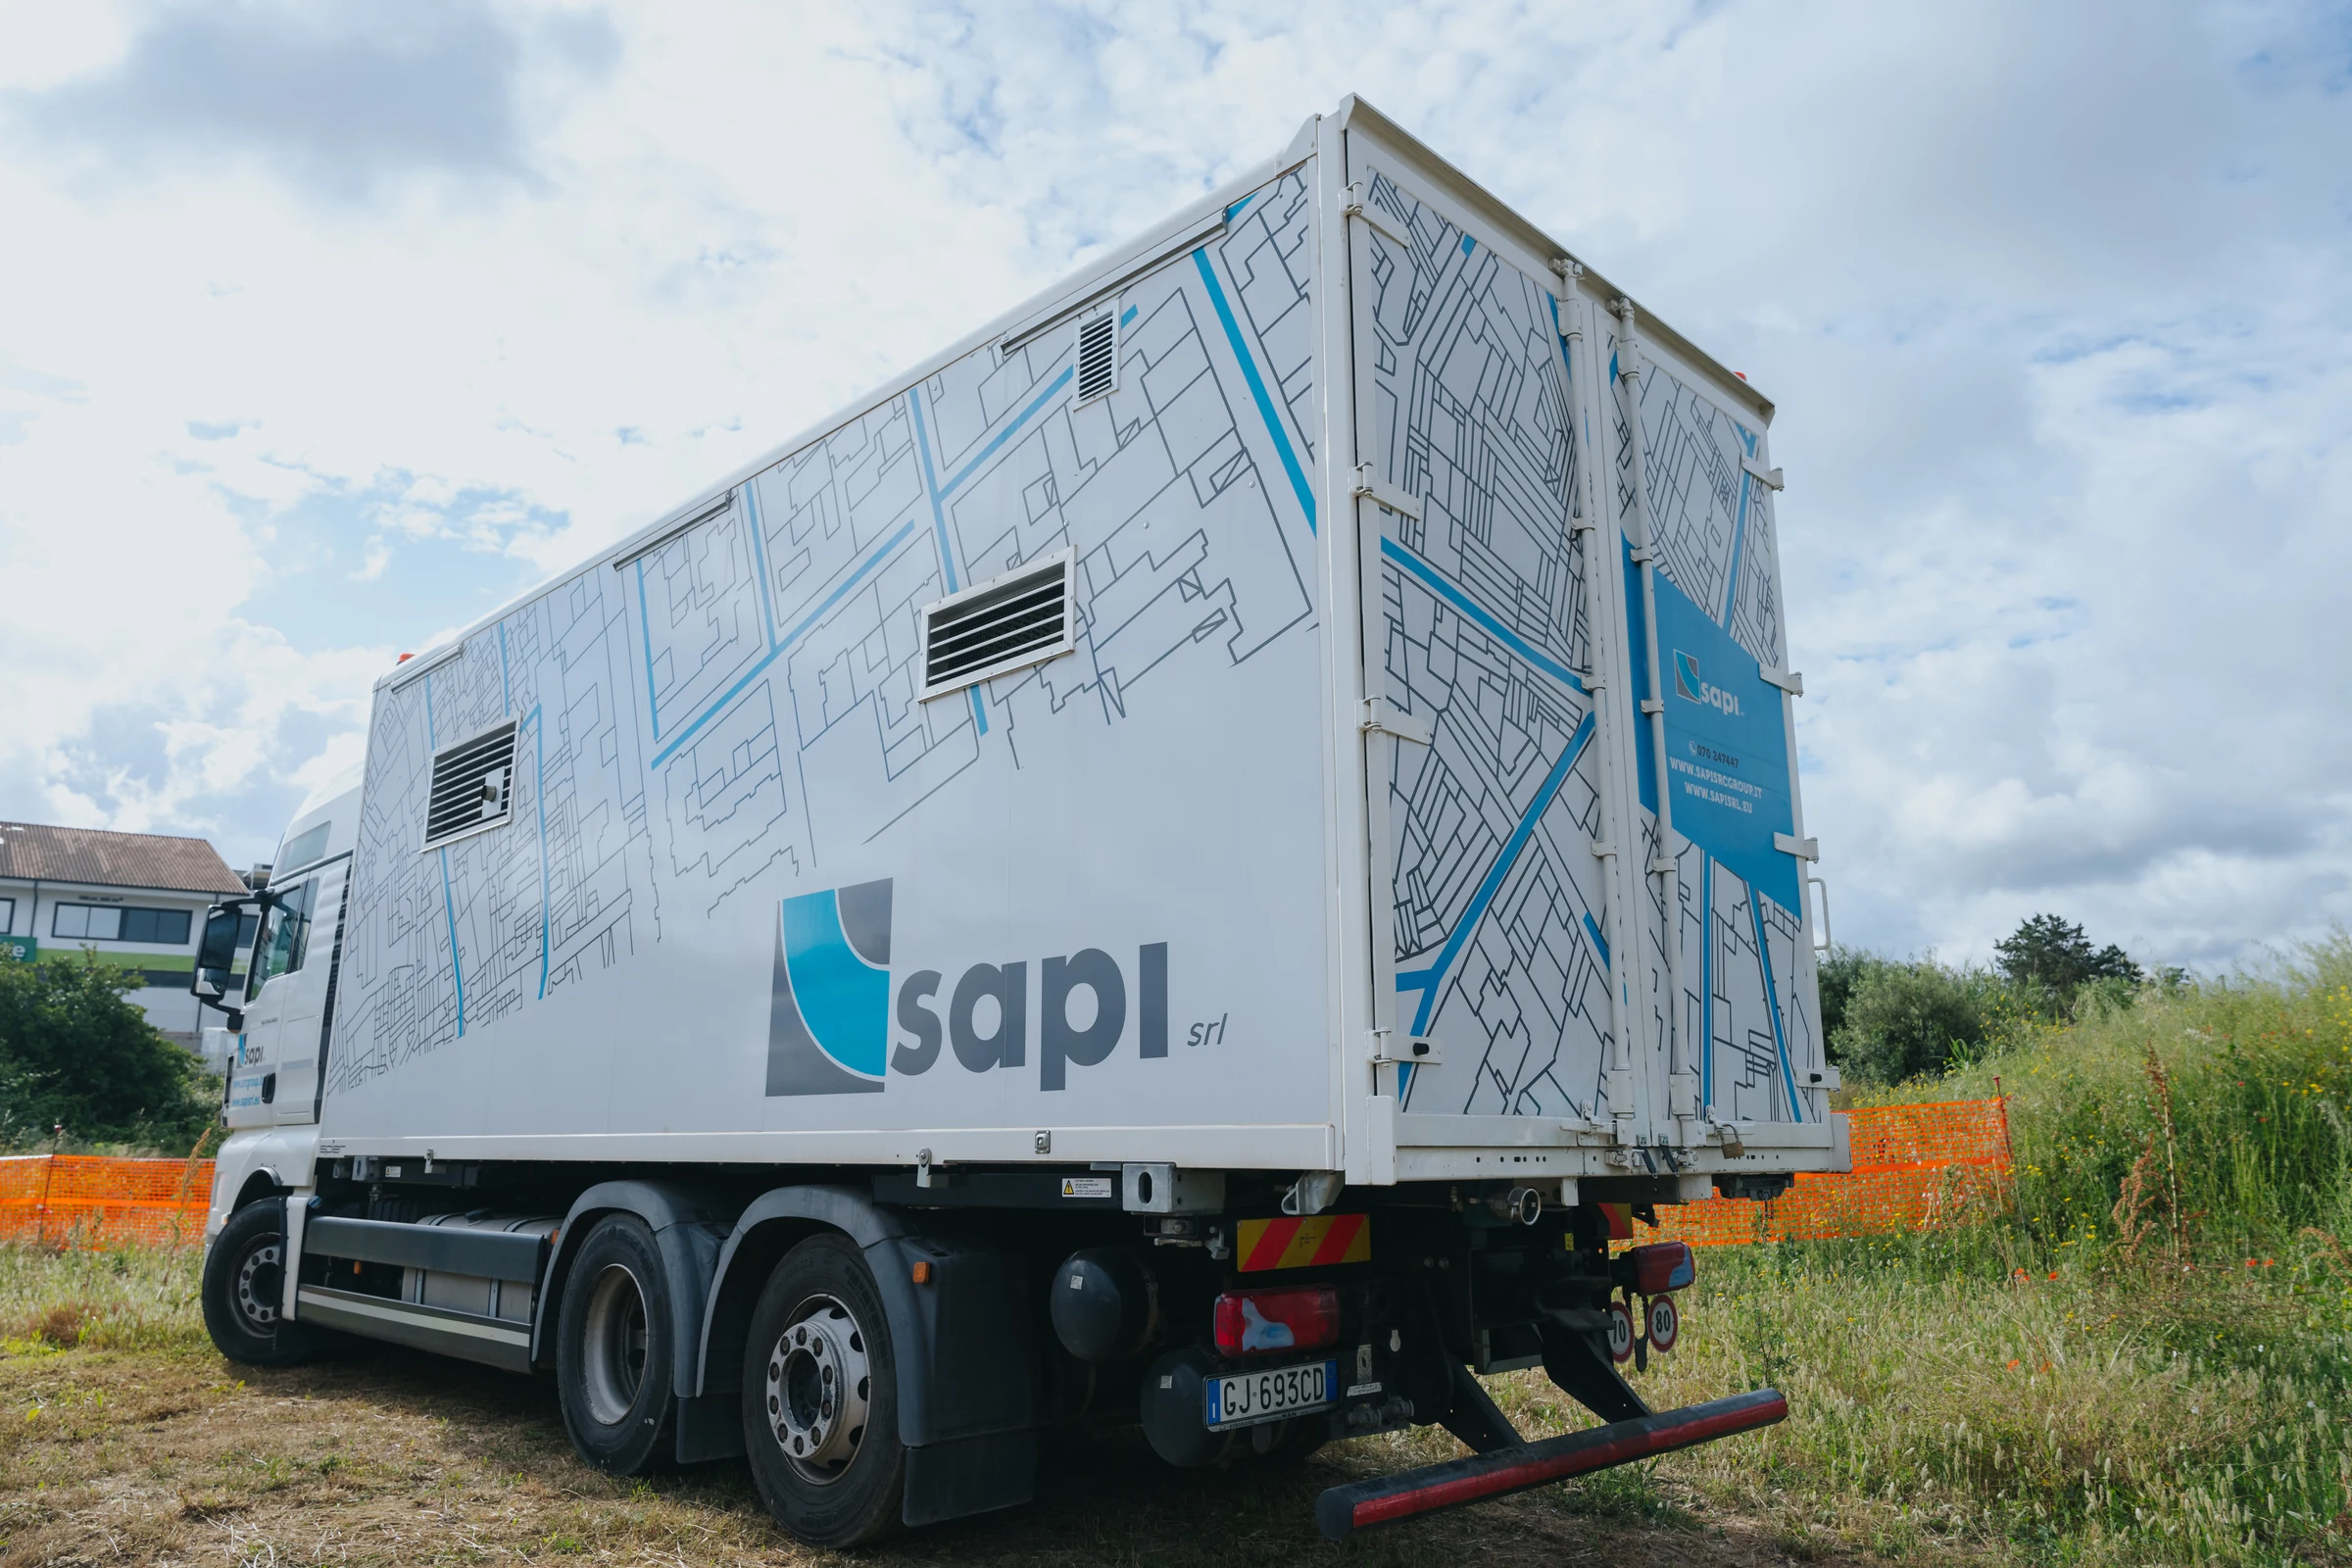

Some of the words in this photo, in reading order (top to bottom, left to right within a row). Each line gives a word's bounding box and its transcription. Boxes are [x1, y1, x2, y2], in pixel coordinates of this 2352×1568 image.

[1696, 745, 1711, 760] 070
[1712, 750, 1740, 769] 247447
[1669, 757, 1763, 799] WWW.SAPISRCGROUP.IT
[1684, 781, 1753, 814] WWW.SAPISRL.EU
[1187, 1012, 1228, 1047] srl
[1655, 1309, 1671, 1334] 80
